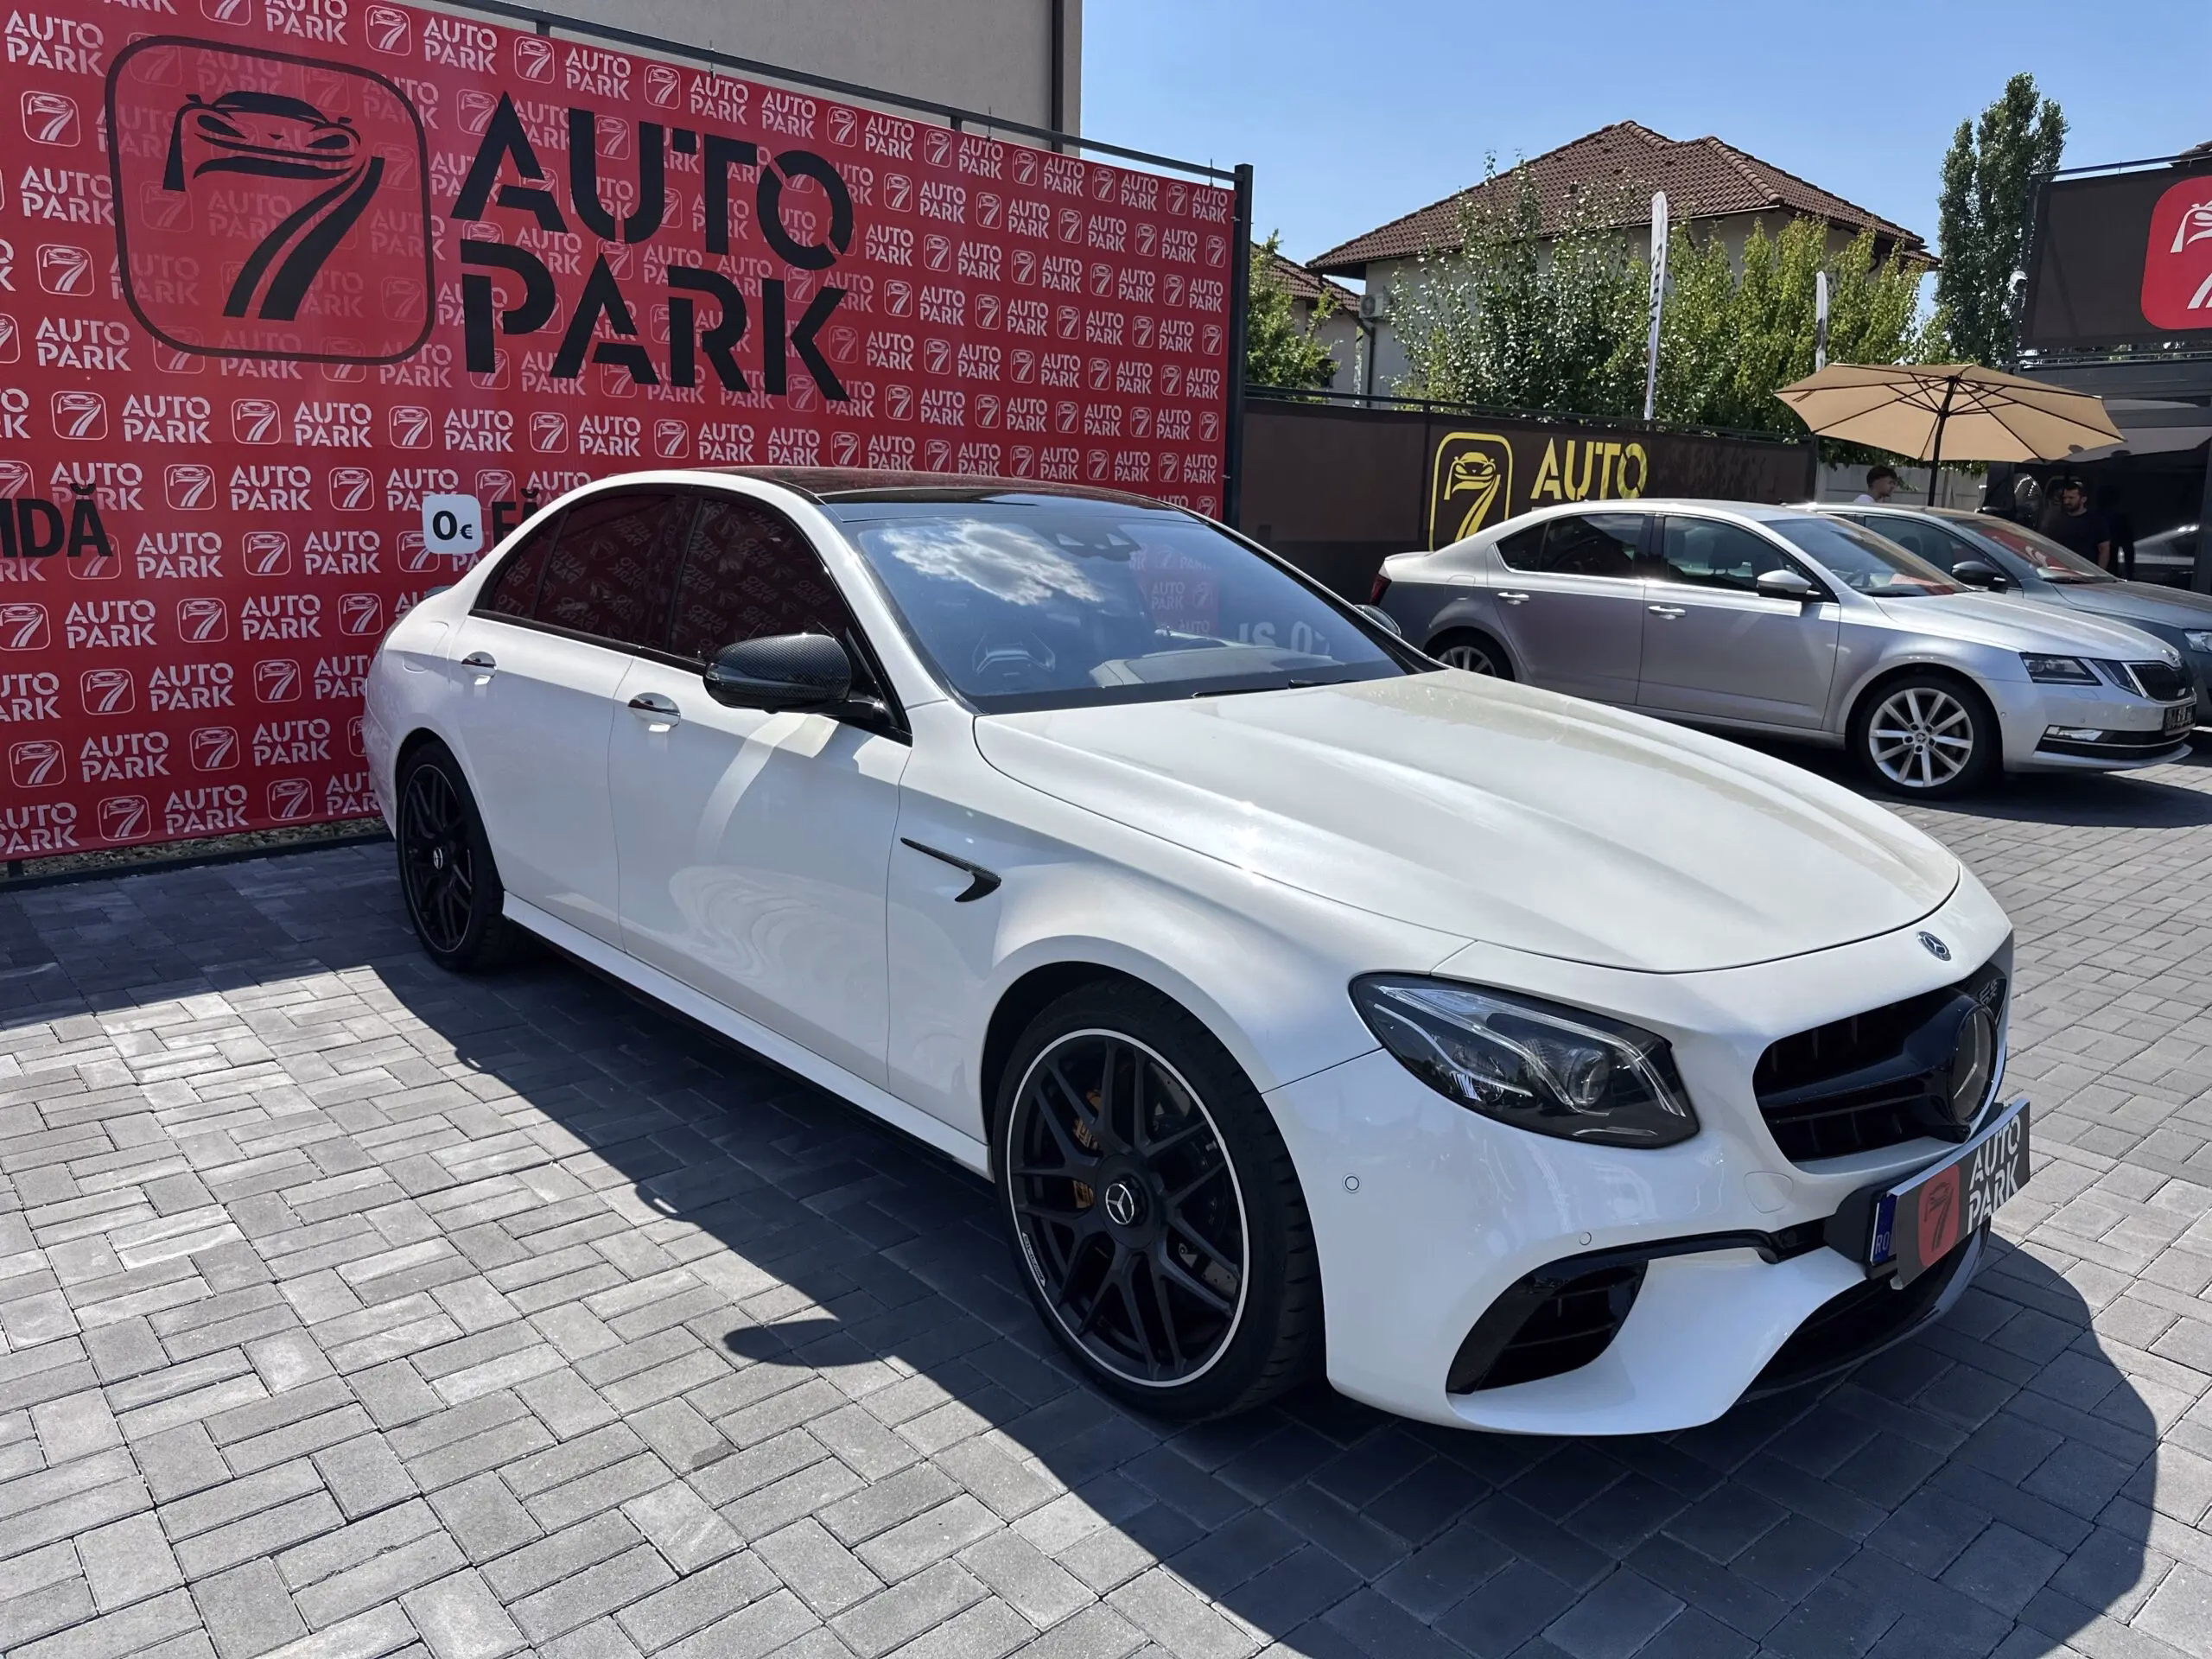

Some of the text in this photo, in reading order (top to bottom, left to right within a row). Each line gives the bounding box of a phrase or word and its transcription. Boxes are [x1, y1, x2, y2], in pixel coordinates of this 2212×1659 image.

[5, 10, 104, 48] AUTO
[266, 6, 346, 45] PARK
[424, 17, 496, 50] AUTO
[6, 35, 104, 77] PARK
[424, 39, 496, 74] PARK
[566, 47, 630, 78] AUTO
[566, 67, 629, 100] PARK
[690, 75, 748, 103] AUTO
[690, 94, 747, 124] PARK
[762, 92, 816, 118] AUTO
[762, 110, 814, 139] PARK
[865, 116, 913, 141] AUTO
[865, 133, 912, 160] PARK
[959, 137, 1003, 161] AUTO
[959, 154, 1001, 179] PARK
[1043, 156, 1084, 179] AUTO
[20, 166, 116, 199] AUTO
[450, 91, 855, 270] AUTO
[1044, 172, 1083, 196] PARK
[1121, 173, 1158, 194] AUTO
[919, 181, 966, 204] AUTO
[1121, 188, 1157, 211] PARK
[1192, 187, 1227, 207] AUTO
[22, 191, 117, 226] PARK
[920, 198, 964, 222] PARK
[1007, 199, 1050, 220] AUTO
[1192, 202, 1225, 224] PARK
[865, 224, 913, 246] AUTO
[1008, 215, 1048, 238] PARK
[1088, 214, 1126, 235] AUTO
[515, 226, 582, 253] AUTO
[1088, 230, 1125, 251] PARK
[1161, 227, 1197, 246] AUTO
[643, 244, 702, 269] AUTO
[866, 242, 912, 265] PARK
[957, 241, 1001, 262] AUTO
[1161, 243, 1196, 264] PARK
[716, 254, 772, 277] AUTO
[958, 258, 1001, 281] PARK
[1042, 255, 1082, 275] AUTO
[823, 270, 873, 293] AUTO
[1042, 271, 1081, 292] PARK
[1118, 267, 1155, 286] AUTO
[1189, 277, 1223, 296] AUTO
[919, 286, 964, 307] AUTO
[1118, 283, 1154, 303] PARK
[1189, 293, 1222, 312] PARK
[460, 238, 851, 402] PARK
[919, 303, 963, 325] PARK
[1007, 299, 1048, 319] AUTO
[1085, 309, 1123, 328] AUTO
[35, 316, 129, 345] AUTO
[1007, 315, 1047, 336] PARK
[1085, 326, 1122, 345] PARK
[1159, 318, 1194, 337] AUTO
[866, 331, 913, 352] AUTO
[957, 343, 1001, 362] AUTO
[1159, 334, 1192, 353] PARK
[36, 341, 130, 371] PARK
[219, 353, 302, 380] PARK
[867, 349, 912, 370] PARK
[1040, 353, 1080, 371] AUTO
[379, 363, 451, 388] PARK
[958, 360, 1000, 380] PARK
[1041, 369, 1079, 387] PARK
[1116, 360, 1153, 378] AUTO
[1185, 367, 1219, 384] AUTO
[522, 372, 585, 394] PARK
[647, 382, 704, 404] PARK
[1116, 376, 1151, 394] PARK
[1185, 382, 1218, 399] PARK
[123, 394, 210, 419] AUTO
[720, 387, 773, 409] PARK
[825, 397, 874, 417] PARK
[920, 389, 964, 407] AUTO
[1007, 397, 1047, 415] AUTO
[294, 401, 372, 424] AUTO
[444, 409, 512, 430] AUTO
[920, 406, 963, 425] PARK
[1007, 414, 1046, 431] PARK
[1084, 404, 1122, 420] AUTO
[1156, 409, 1191, 424] AUTO
[123, 417, 210, 443] PARK
[295, 423, 372, 448] PARK
[578, 415, 639, 435] AUTO
[698, 423, 753, 442] AUTO
[1084, 419, 1120, 436] PARK
[1156, 423, 1190, 440] PARK
[445, 429, 512, 452] PARK
[579, 435, 640, 455] PARK
[767, 427, 819, 446] AUTO
[868, 435, 914, 453] AUTO
[698, 441, 753, 461] PARK
[768, 446, 818, 464] PARK
[957, 442, 1001, 459] AUTO
[1039, 447, 1079, 463] AUTO
[1115, 450, 1150, 466] AUTO
[1183, 454, 1217, 468] AUTO
[49, 461, 142, 486] AUTO
[229, 465, 310, 487] AUTO
[386, 468, 458, 489] AUTO
[1040, 463, 1077, 479] PARK
[1115, 466, 1148, 481] PARK
[1184, 468, 1216, 483] PARK
[1530, 437, 1647, 501] AUTO
[231, 488, 310, 511] PARK
[135, 532, 221, 554] AUTO
[303, 531, 379, 551] AUTO
[137, 556, 222, 578] PARK
[304, 553, 379, 575] PARK
[65, 600, 155, 623] AUTO
[240, 594, 320, 617] AUTO
[66, 623, 156, 648] PARK
[242, 617, 320, 640] PARK
[149, 662, 233, 687] AUTO
[314, 656, 369, 677] AUT
[150, 685, 233, 711] PARK
[315, 677, 365, 699] PAR
[252, 718, 330, 743] AUTO
[79, 731, 168, 759] AUTO
[253, 740, 330, 766] PARK
[81, 753, 168, 782] PARK
[164, 785, 246, 812] AUTO
[327, 792, 380, 815] PAR
[166, 806, 247, 834] PARK
[1969, 1114, 2021, 1190] AUTO
[1967, 1154, 2020, 1234] PARK
[1875, 1231, 1891, 1255] RO
